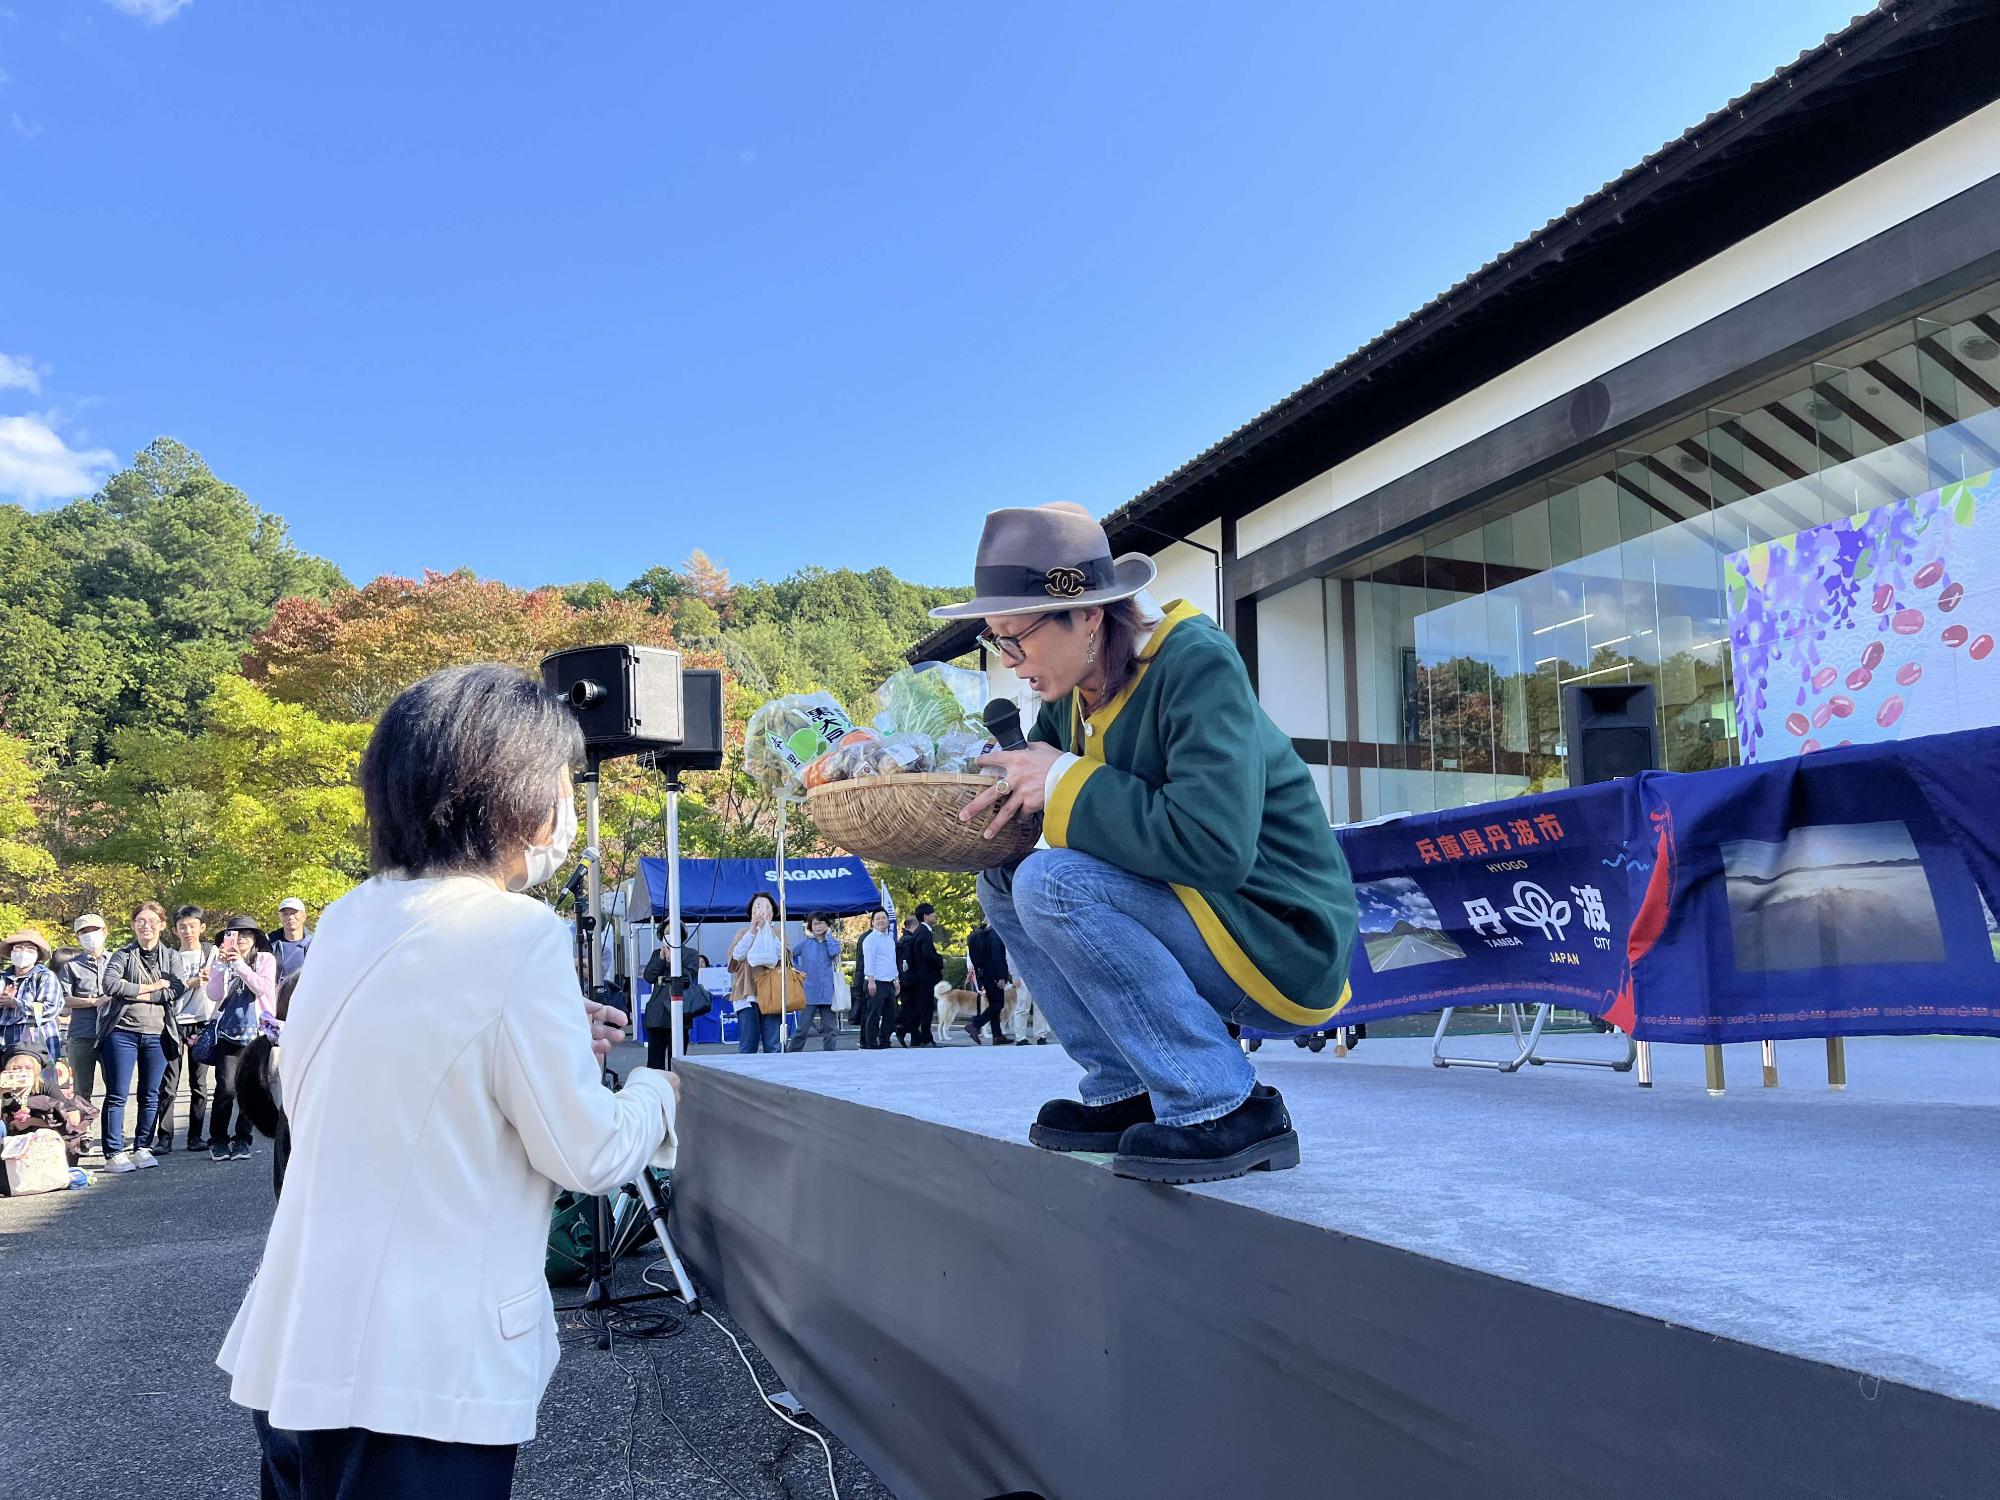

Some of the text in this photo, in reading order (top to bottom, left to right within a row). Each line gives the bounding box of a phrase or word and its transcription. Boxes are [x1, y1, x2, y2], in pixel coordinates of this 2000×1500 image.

[1415, 813, 1565, 865] 兵庫県丹波市
[1486, 859, 1528, 873] HYOGO
[765, 867, 852, 881] SAGAWA
[1463, 884, 1610, 936] 丹 波
[1484, 936, 1611, 950] TAMBA CITY
[1550, 951, 1580, 965] JAPAN
